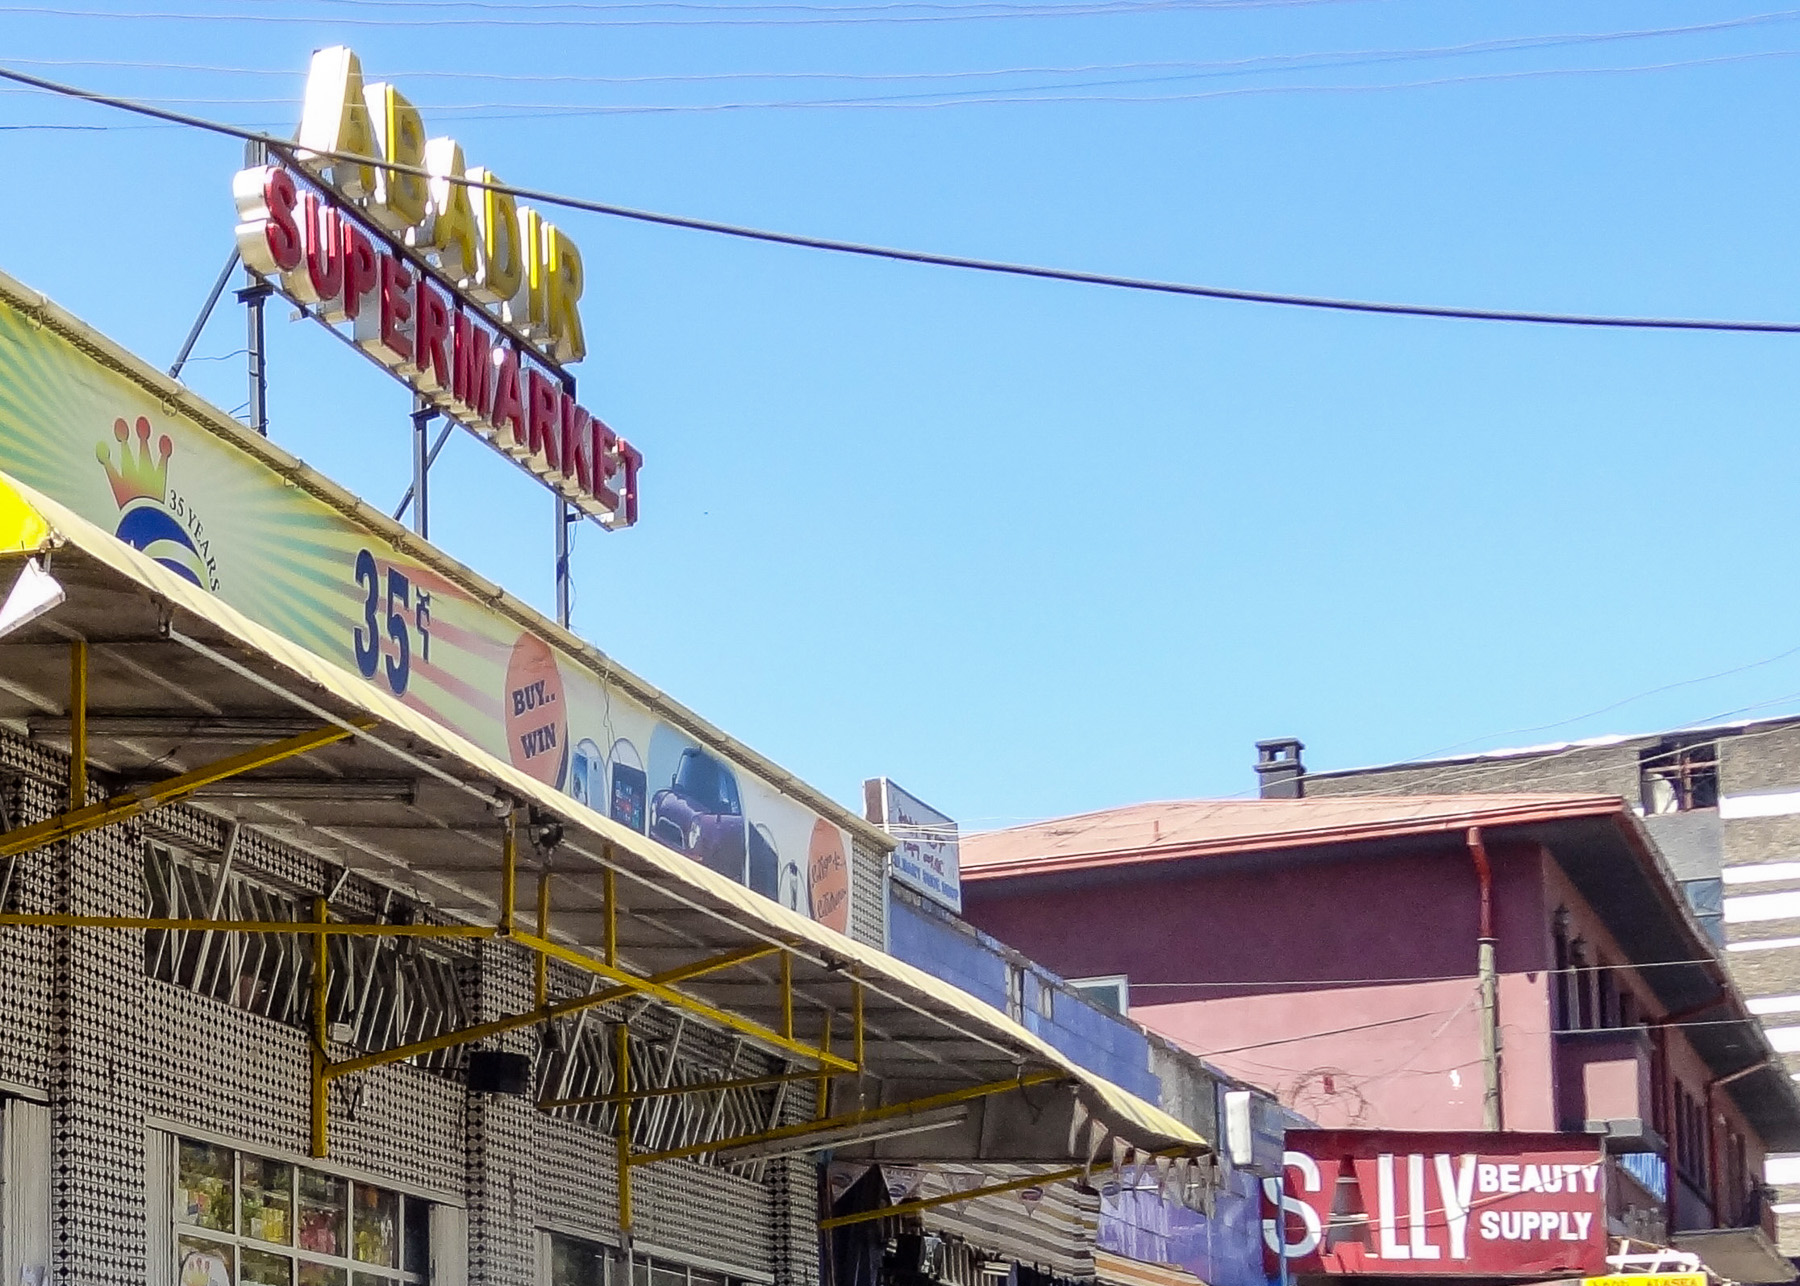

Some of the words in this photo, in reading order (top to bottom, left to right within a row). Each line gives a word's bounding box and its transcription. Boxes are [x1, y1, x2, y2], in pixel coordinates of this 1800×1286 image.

[299, 45, 587, 363] ABADIR
[233, 165, 644, 531] SUPERMARKET
[169, 489, 185, 518] 35
[187, 507, 221, 592] YEARS
[512, 680, 556, 717] BUY..
[520, 722, 557, 760] WIN
[1262, 1151, 1479, 1260] SALLY
[1478, 1163, 1599, 1194] BEAUTY
[1479, 1210, 1593, 1241] SUPPLY
